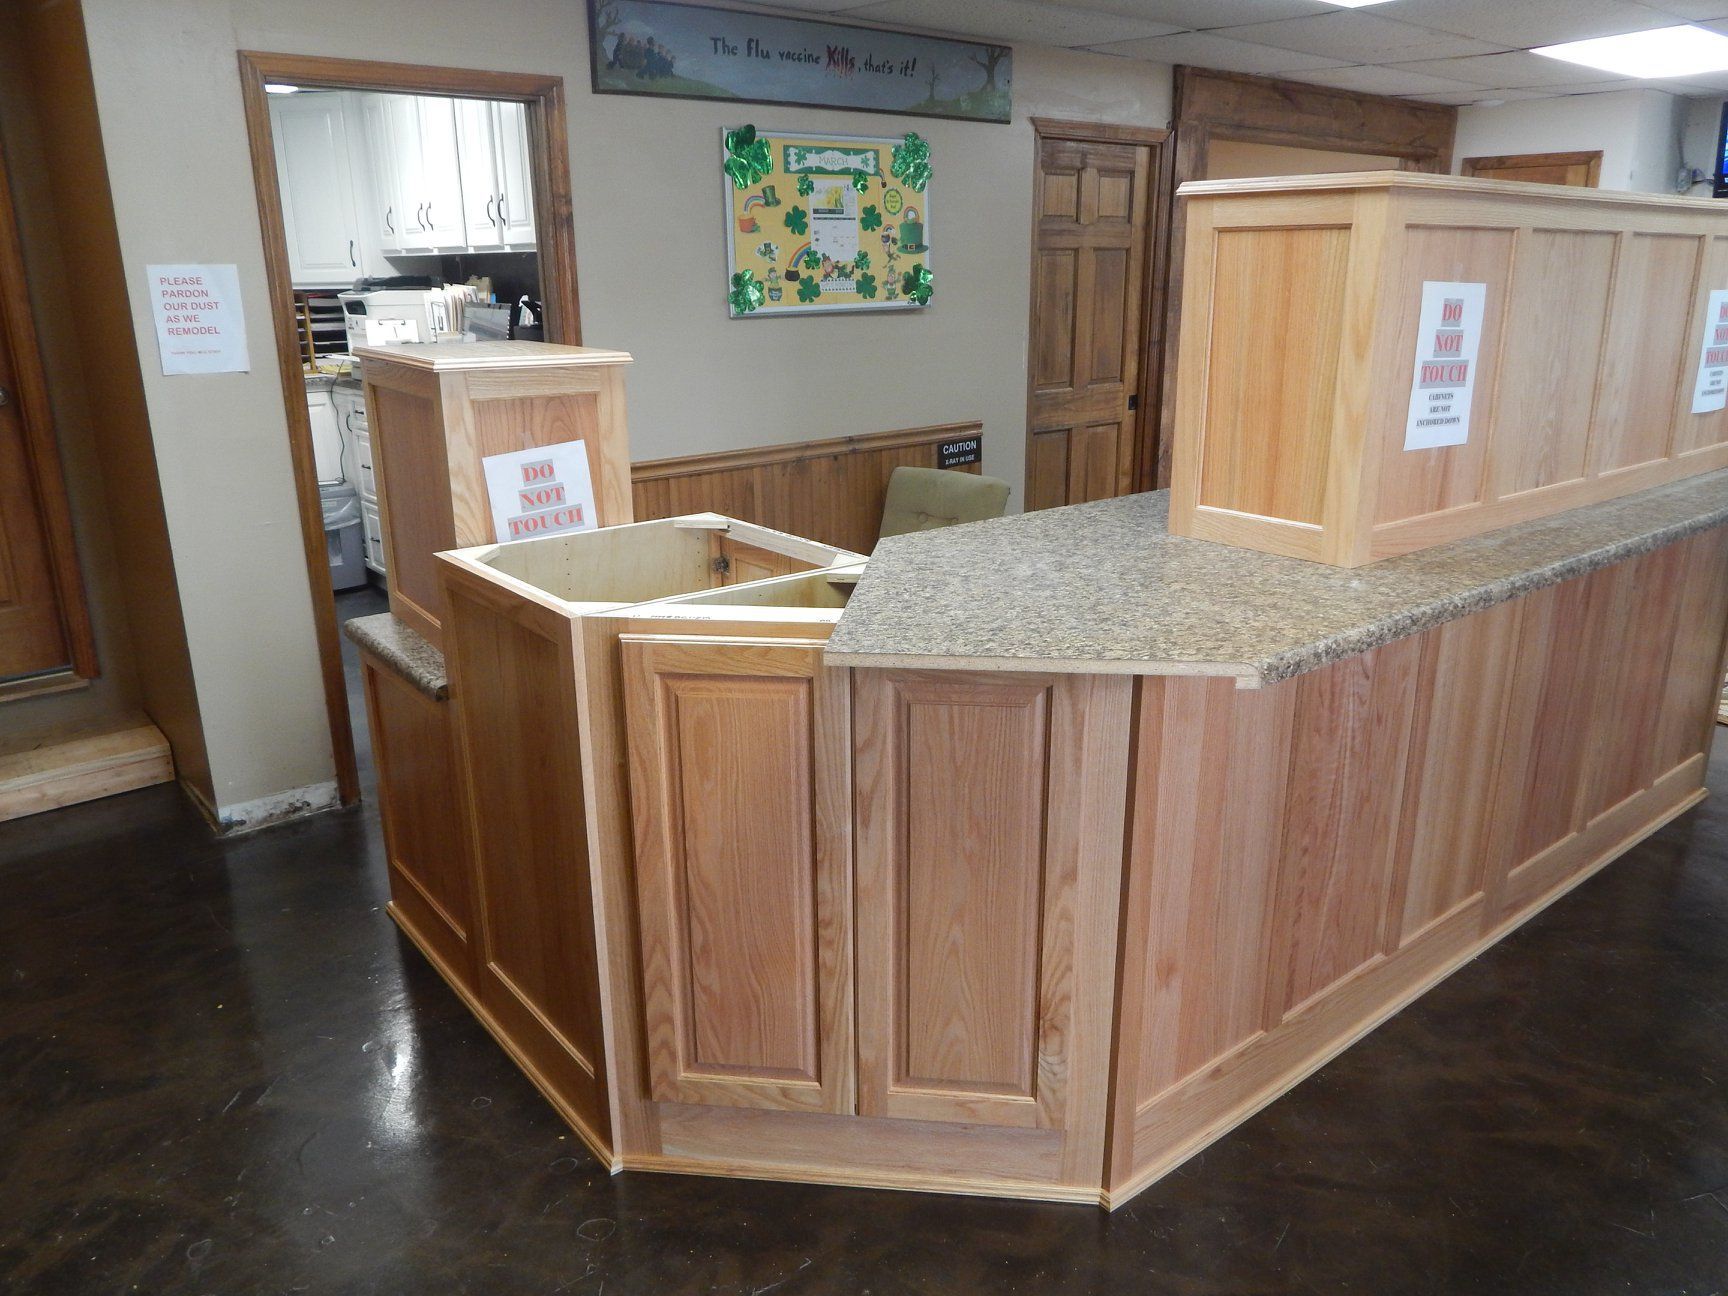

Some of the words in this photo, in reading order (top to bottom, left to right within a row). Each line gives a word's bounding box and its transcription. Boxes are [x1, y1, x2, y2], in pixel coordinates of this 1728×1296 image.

[709, 36, 738, 56] The
[778, 47, 821, 65] vaccine
[864, 52, 894, 74] that's
[900, 57, 917, 77] it!
[818, 155, 849, 166] MARCH
[159, 276, 203, 286] PLEASE
[161, 289, 209, 298] PARDON
[163, 302, 188, 311] OUR
[191, 301, 220, 310] DUST
[1442, 303, 1463, 321] DO
[165, 315, 180, 323] AS
[182, 314, 201, 323] WE
[167, 326, 221, 336] REMODEL
[1434, 334, 1464, 352] NOT
[1421, 364, 1468, 384] TOUCH
[943, 440, 976, 454] CAUTION
[522, 463, 555, 482] DO
[519, 486, 565, 507] NOT
[508, 508, 583, 535] TOUCH
